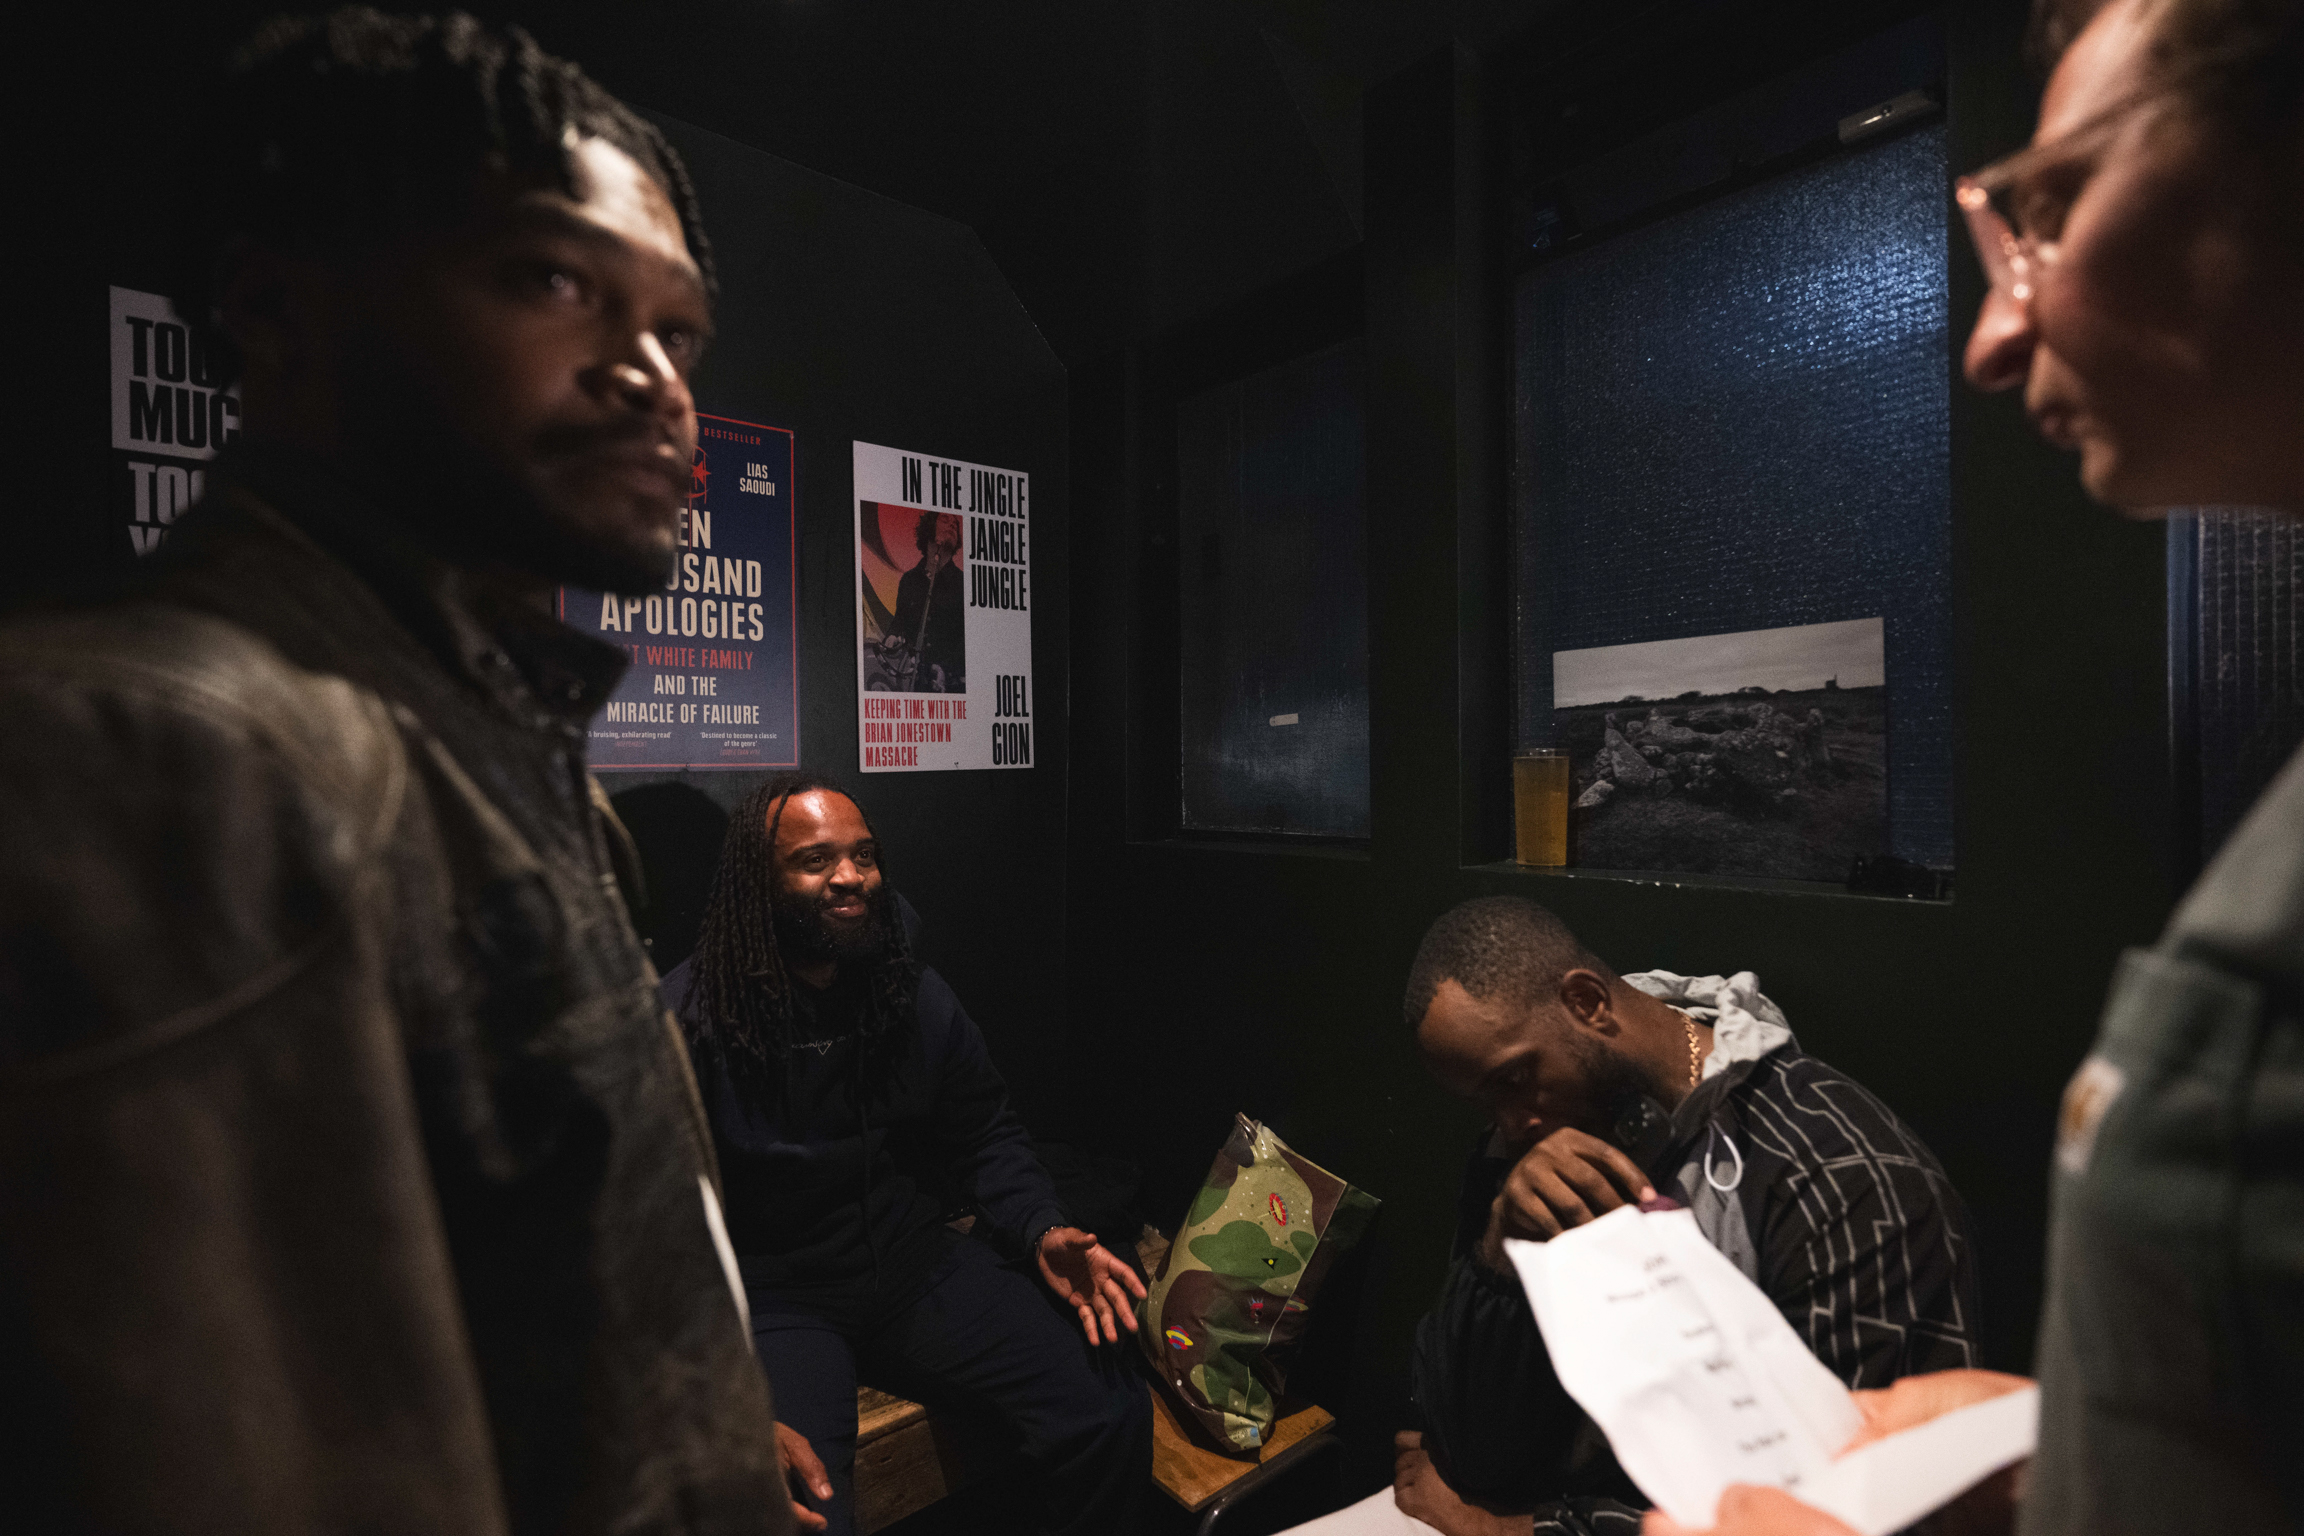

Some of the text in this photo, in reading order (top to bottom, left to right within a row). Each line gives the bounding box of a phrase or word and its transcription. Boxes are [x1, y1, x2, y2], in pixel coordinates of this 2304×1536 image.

[129, 379, 242, 451] MUC
[704, 427, 761, 445] BESTSELLER
[747, 462, 768, 479] LIAS
[740, 477, 775, 496] SAOUDI
[902, 456, 1026, 519] IN THE JINGLE
[677, 507, 711, 549] EN
[969, 516, 1026, 565] JANGLE
[970, 564, 1027, 611] JUNGLE
[600, 591, 764, 641] APOLOGIES
[646, 645, 695, 668] WHITE
[701, 649, 754, 670] FAMILY
[654, 674, 717, 696] AND THE
[995, 675, 1029, 717] JOEL
[607, 702, 760, 725] MIRACLE OF FAILURE
[865, 698, 967, 720] KEEPING TIME WITH THE
[621, 731, 656, 739] exhilarating
[866, 722, 951, 743] BRIAN JONESTOWN
[992, 722, 1030, 765] GION
[866, 746, 918, 766] MASSACRE
